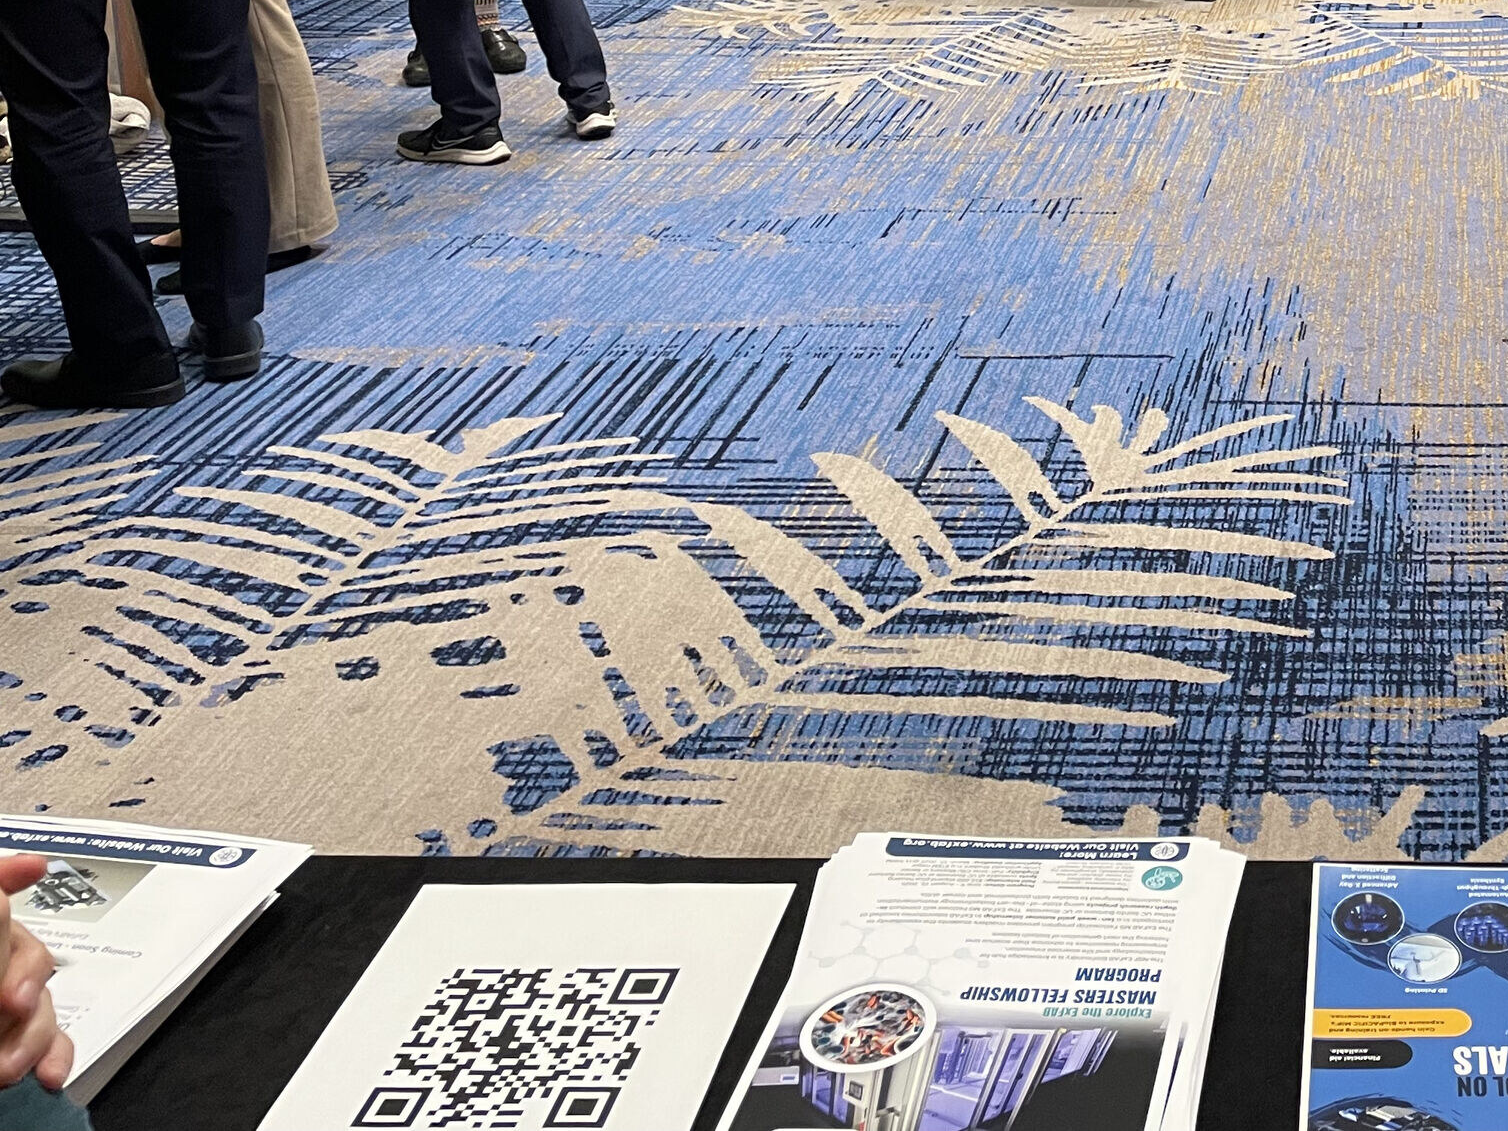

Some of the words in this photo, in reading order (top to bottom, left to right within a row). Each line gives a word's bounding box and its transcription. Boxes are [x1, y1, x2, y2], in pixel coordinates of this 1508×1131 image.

[0, 831, 86, 846] www.exfab.o
[902, 838, 1006, 848] www.exfab.org
[87, 838, 146, 852] Website:
[145, 843, 172, 854] Our
[1110, 843, 1139, 851] Visit
[171, 846, 203, 857] Visit
[72, 944, 99, 953] Soon
[101, 946, 142, 958] Coming
[1075, 967, 1162, 983] PROGRAM
[960, 986, 1069, 1003] FELLOWSHIP
[1073, 989, 1156, 1005] MASTERS
[1042, 1007, 1078, 1017] ExFAB
[1082, 1007, 1102, 1017] the
[1106, 1006, 1152, 1019] Explore
[1457, 1076, 1487, 1097] ON
